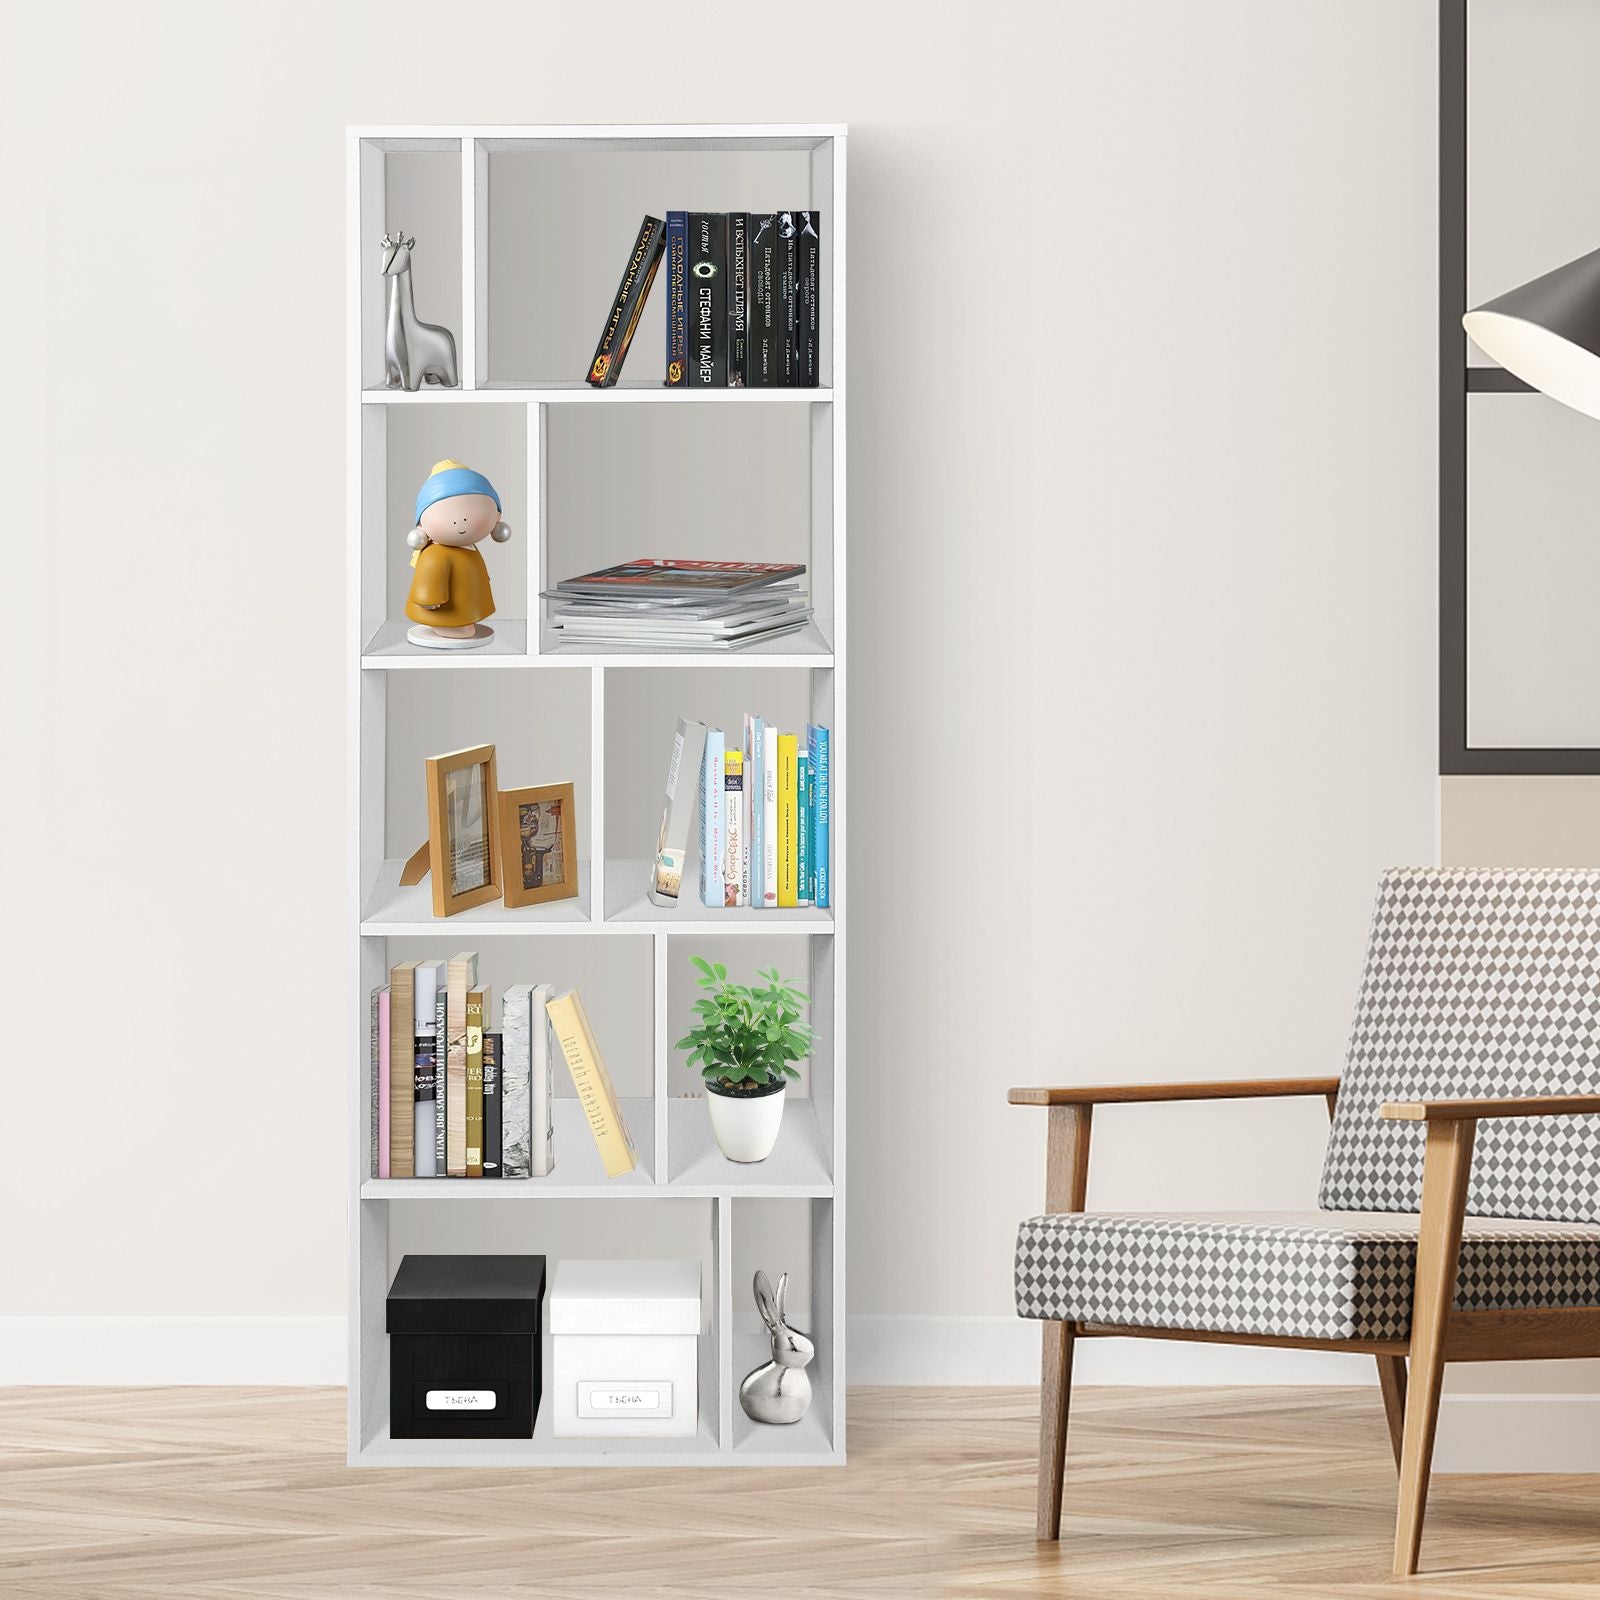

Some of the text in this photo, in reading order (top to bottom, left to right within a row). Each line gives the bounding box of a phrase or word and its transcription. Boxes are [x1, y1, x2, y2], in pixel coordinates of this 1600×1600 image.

[735, 218, 744, 228] И
[735, 229, 744, 289] ВСПЫХНЕТ
[602, 222, 653, 350] ГОЛОДНЫЕ ИГРЫ
[699, 288, 714, 383] СТЕФАНИ МАЙЕР
